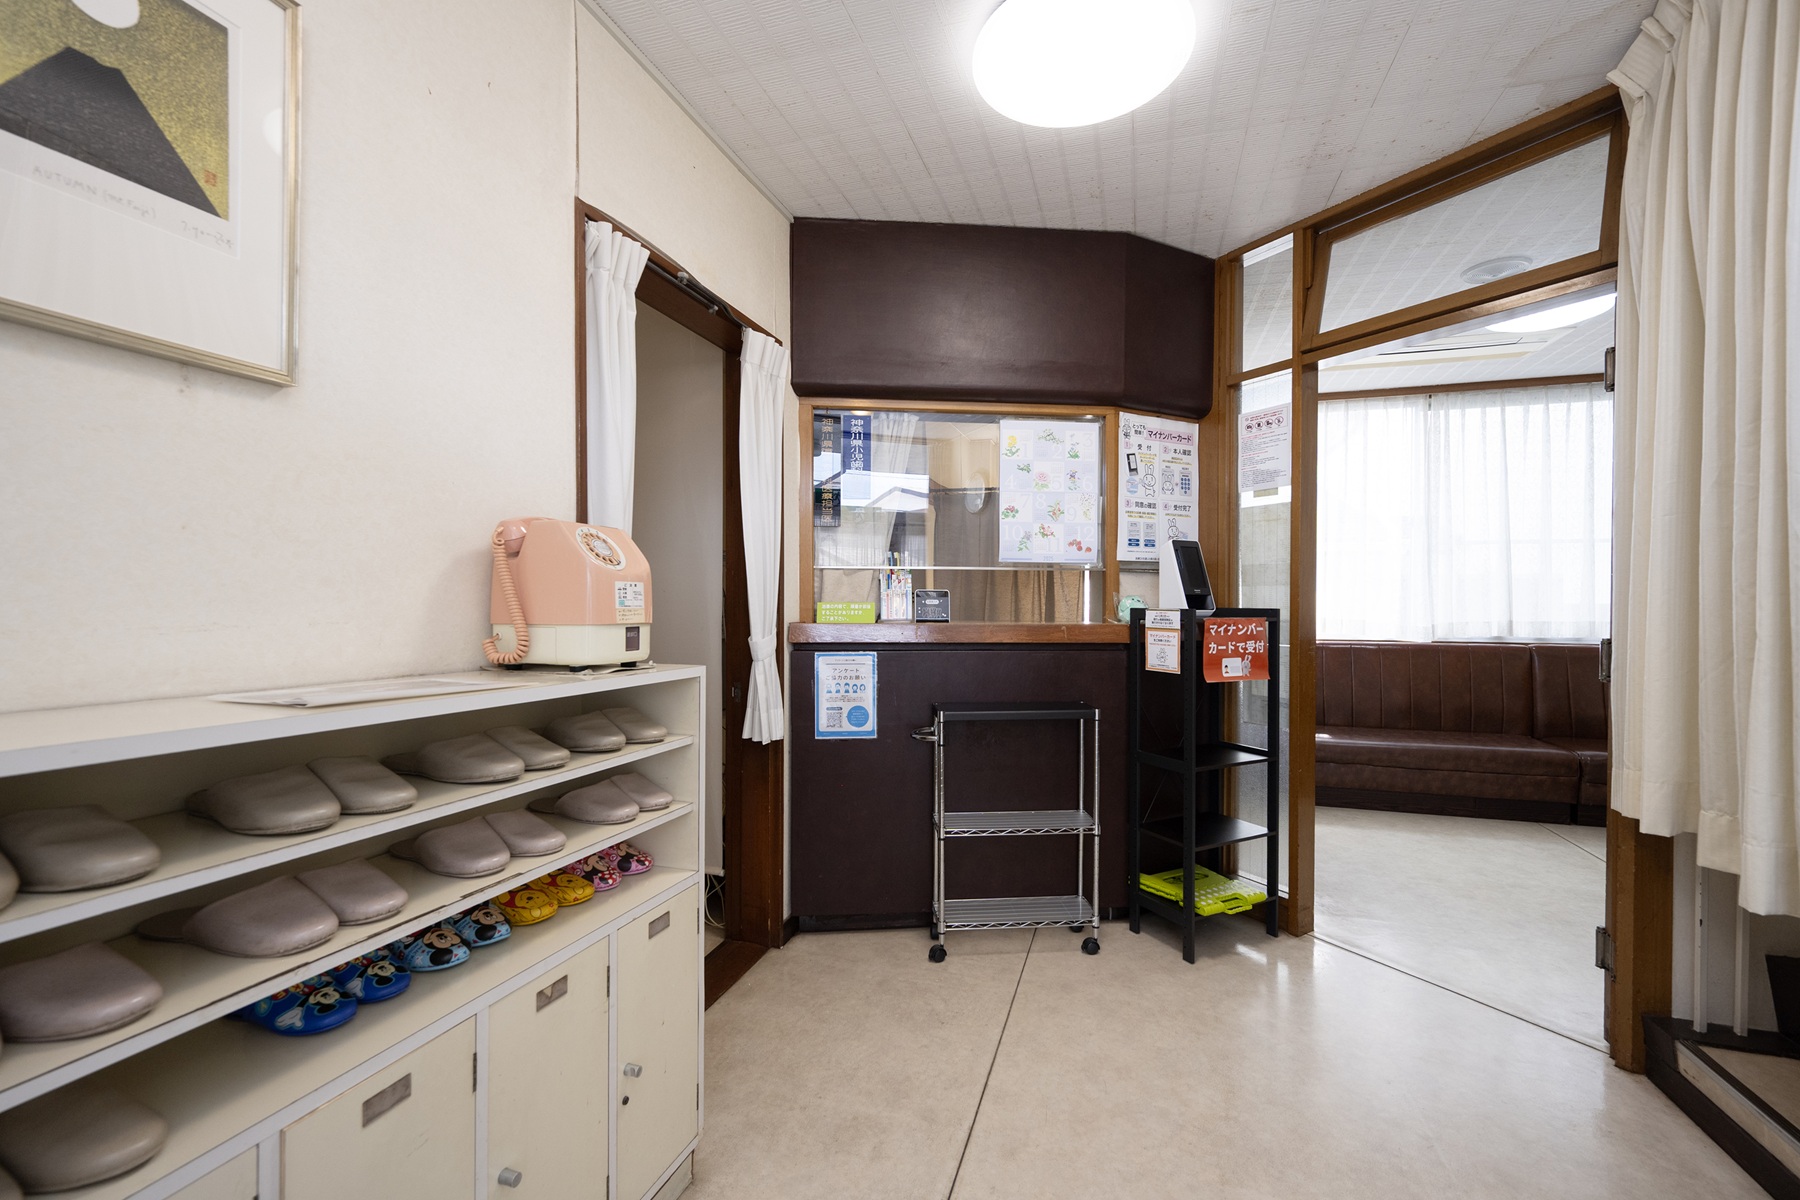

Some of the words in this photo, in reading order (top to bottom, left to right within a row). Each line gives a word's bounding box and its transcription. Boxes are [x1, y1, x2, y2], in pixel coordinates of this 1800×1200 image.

[1083, 432, 1093, 447] 3
[1147, 430, 1192, 443] マイナンバーカード
[1173, 448, 1192, 456] 本人確認
[1005, 474, 1017, 489] 4
[1052, 476, 1062, 490] 5
[1083, 476, 1093, 490] 6
[1021, 493, 1031, 508] 7
[1036, 493, 1046, 508] 8
[1134, 501, 1157, 509] 同意の確認
[1066, 506, 1077, 521] 9
[1173, 504, 1192, 512] 受付完了
[1004, 524, 1023, 540] 10
[1077, 525, 1095, 540] 12
[1209, 623, 1264, 636] マイナンバー
[1208, 640, 1265, 654] カードで受付
